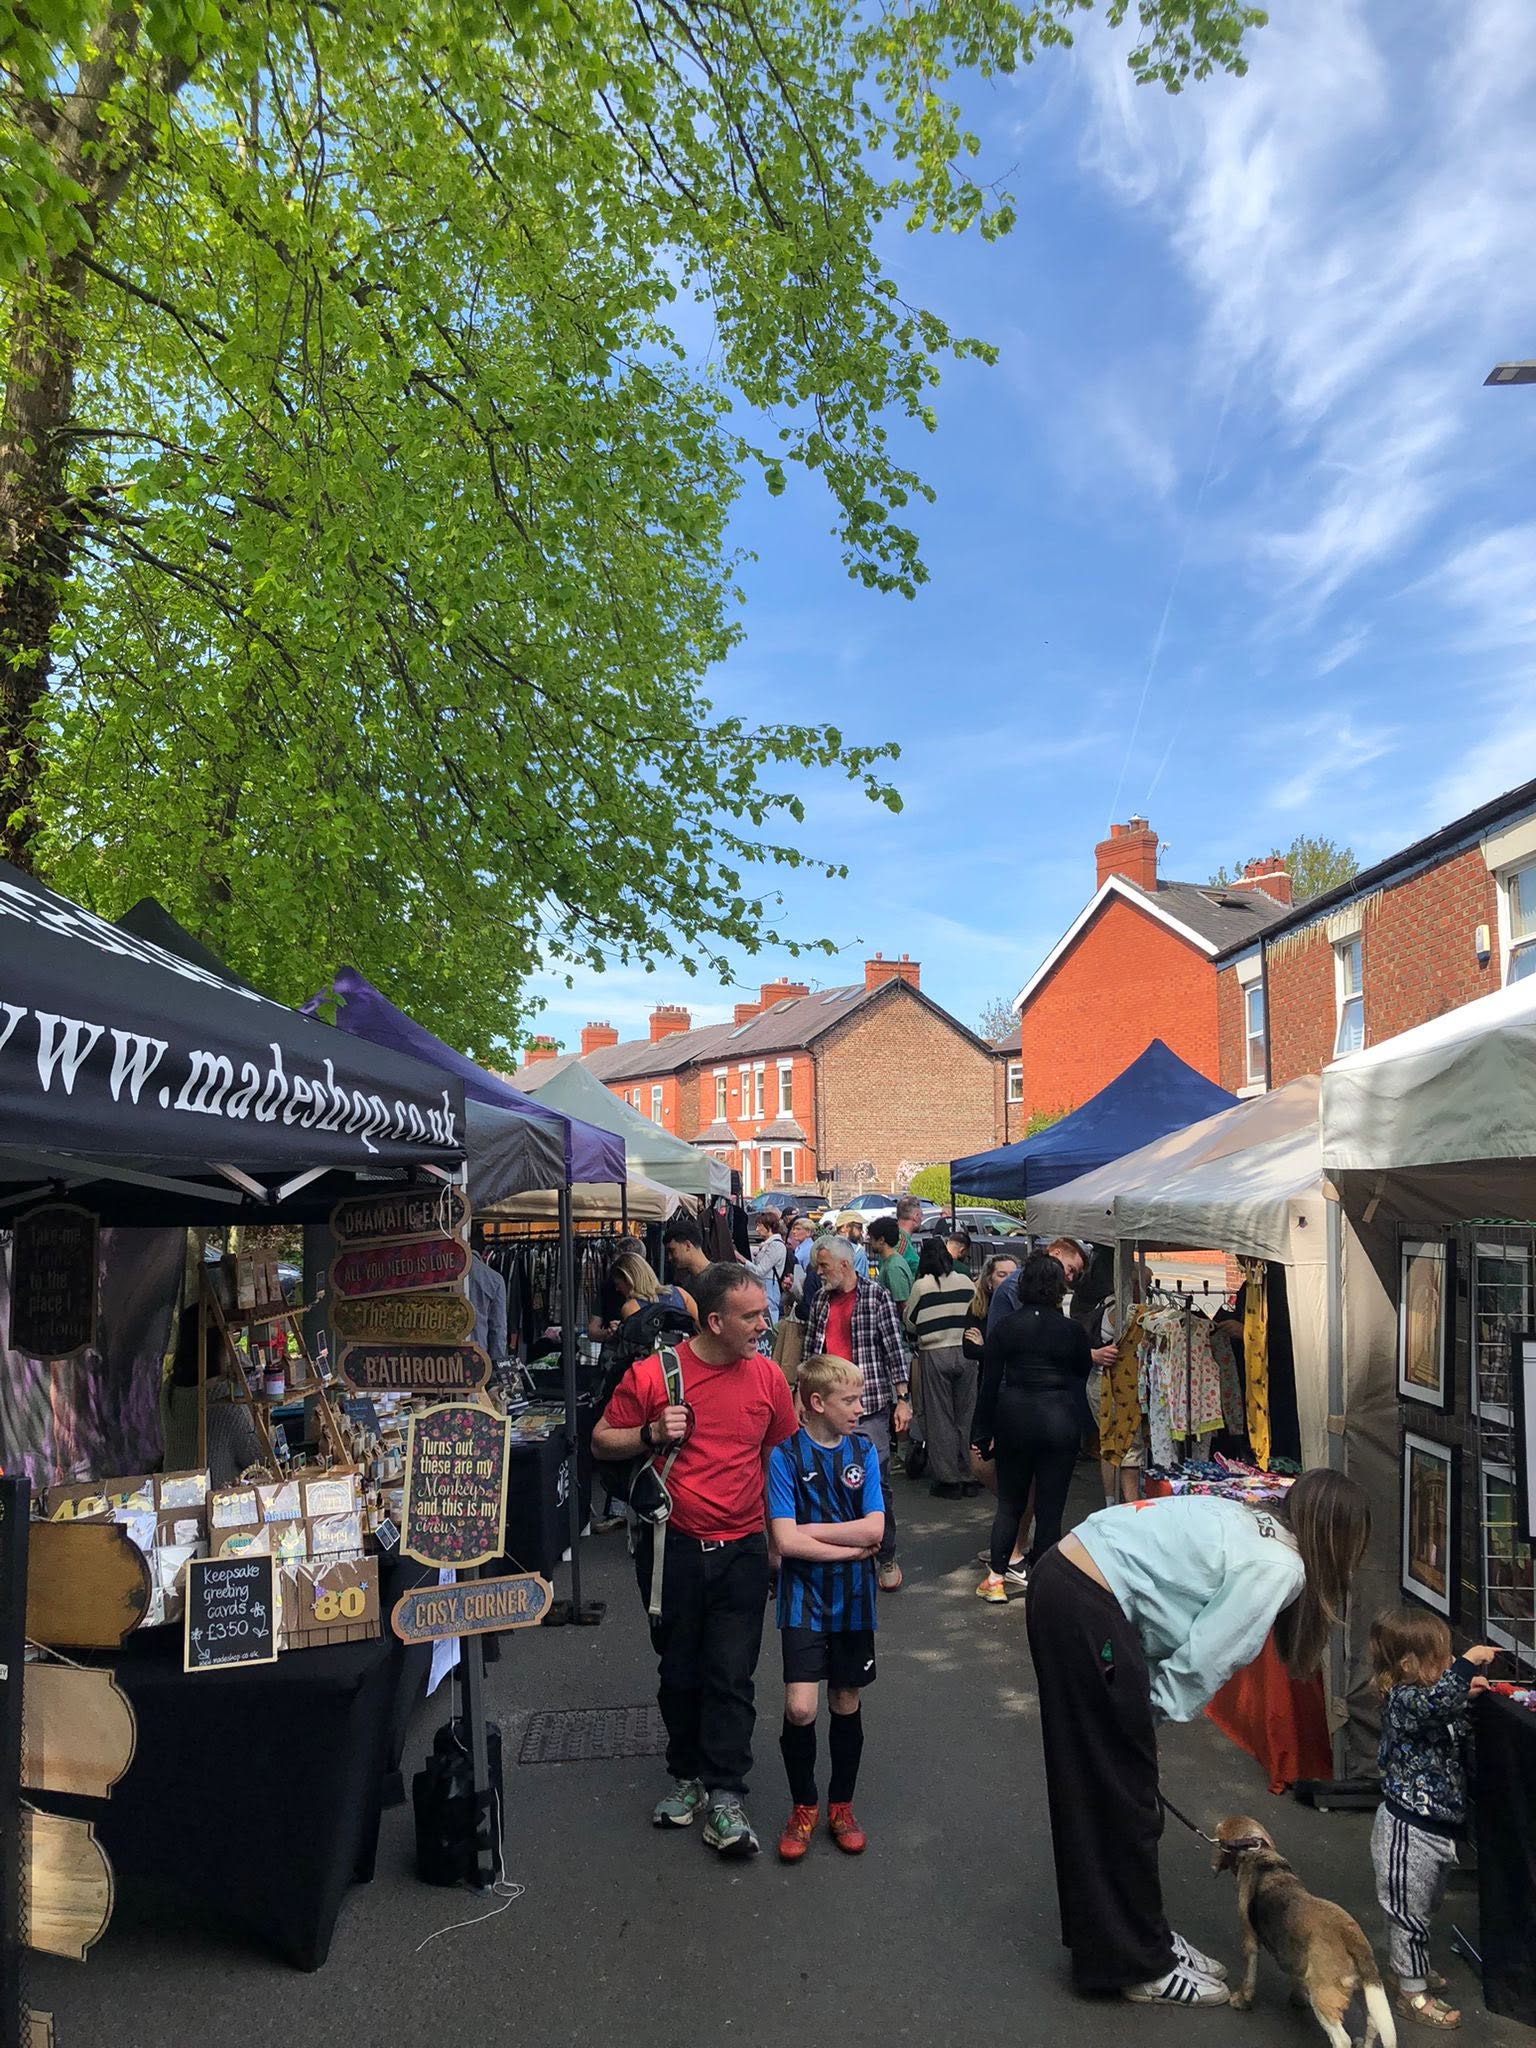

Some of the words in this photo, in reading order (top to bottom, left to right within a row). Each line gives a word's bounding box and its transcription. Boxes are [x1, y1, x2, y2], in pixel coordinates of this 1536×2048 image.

[345, 1203, 417, 1232] DRAMATIC
[422, 1198, 454, 1225] EXIT
[344, 1267, 362, 1282] ALL
[366, 1261, 385, 1280] YOU
[388, 1258, 414, 1277] NEED
[416, 1257, 427, 1272] IS
[430, 1252, 456, 1271] LOVE
[362, 1305, 387, 1327] The
[393, 1303, 449, 1330] Garden
[365, 1356, 465, 1385] BATHROOM
[421, 1436, 453, 1456] Turns
[455, 1440, 474, 1456] out
[420, 1456, 451, 1475] these
[454, 1460, 473, 1475] are
[476, 1459, 494, 1479] my
[416, 1477, 486, 1501] Monkeys
[416, 1498, 437, 1516] and
[442, 1498, 464, 1517] this
[467, 1498, 477, 1517] is
[480, 1502, 498, 1522] my
[415, 1518, 457, 1535] circus
[203, 1584, 249, 1606] greeting
[313, 1586, 367, 1622] 80
[207, 1600, 247, 1619] cards
[415, 1598, 458, 1629] COSY
[464, 1588, 528, 1621] CORNER
